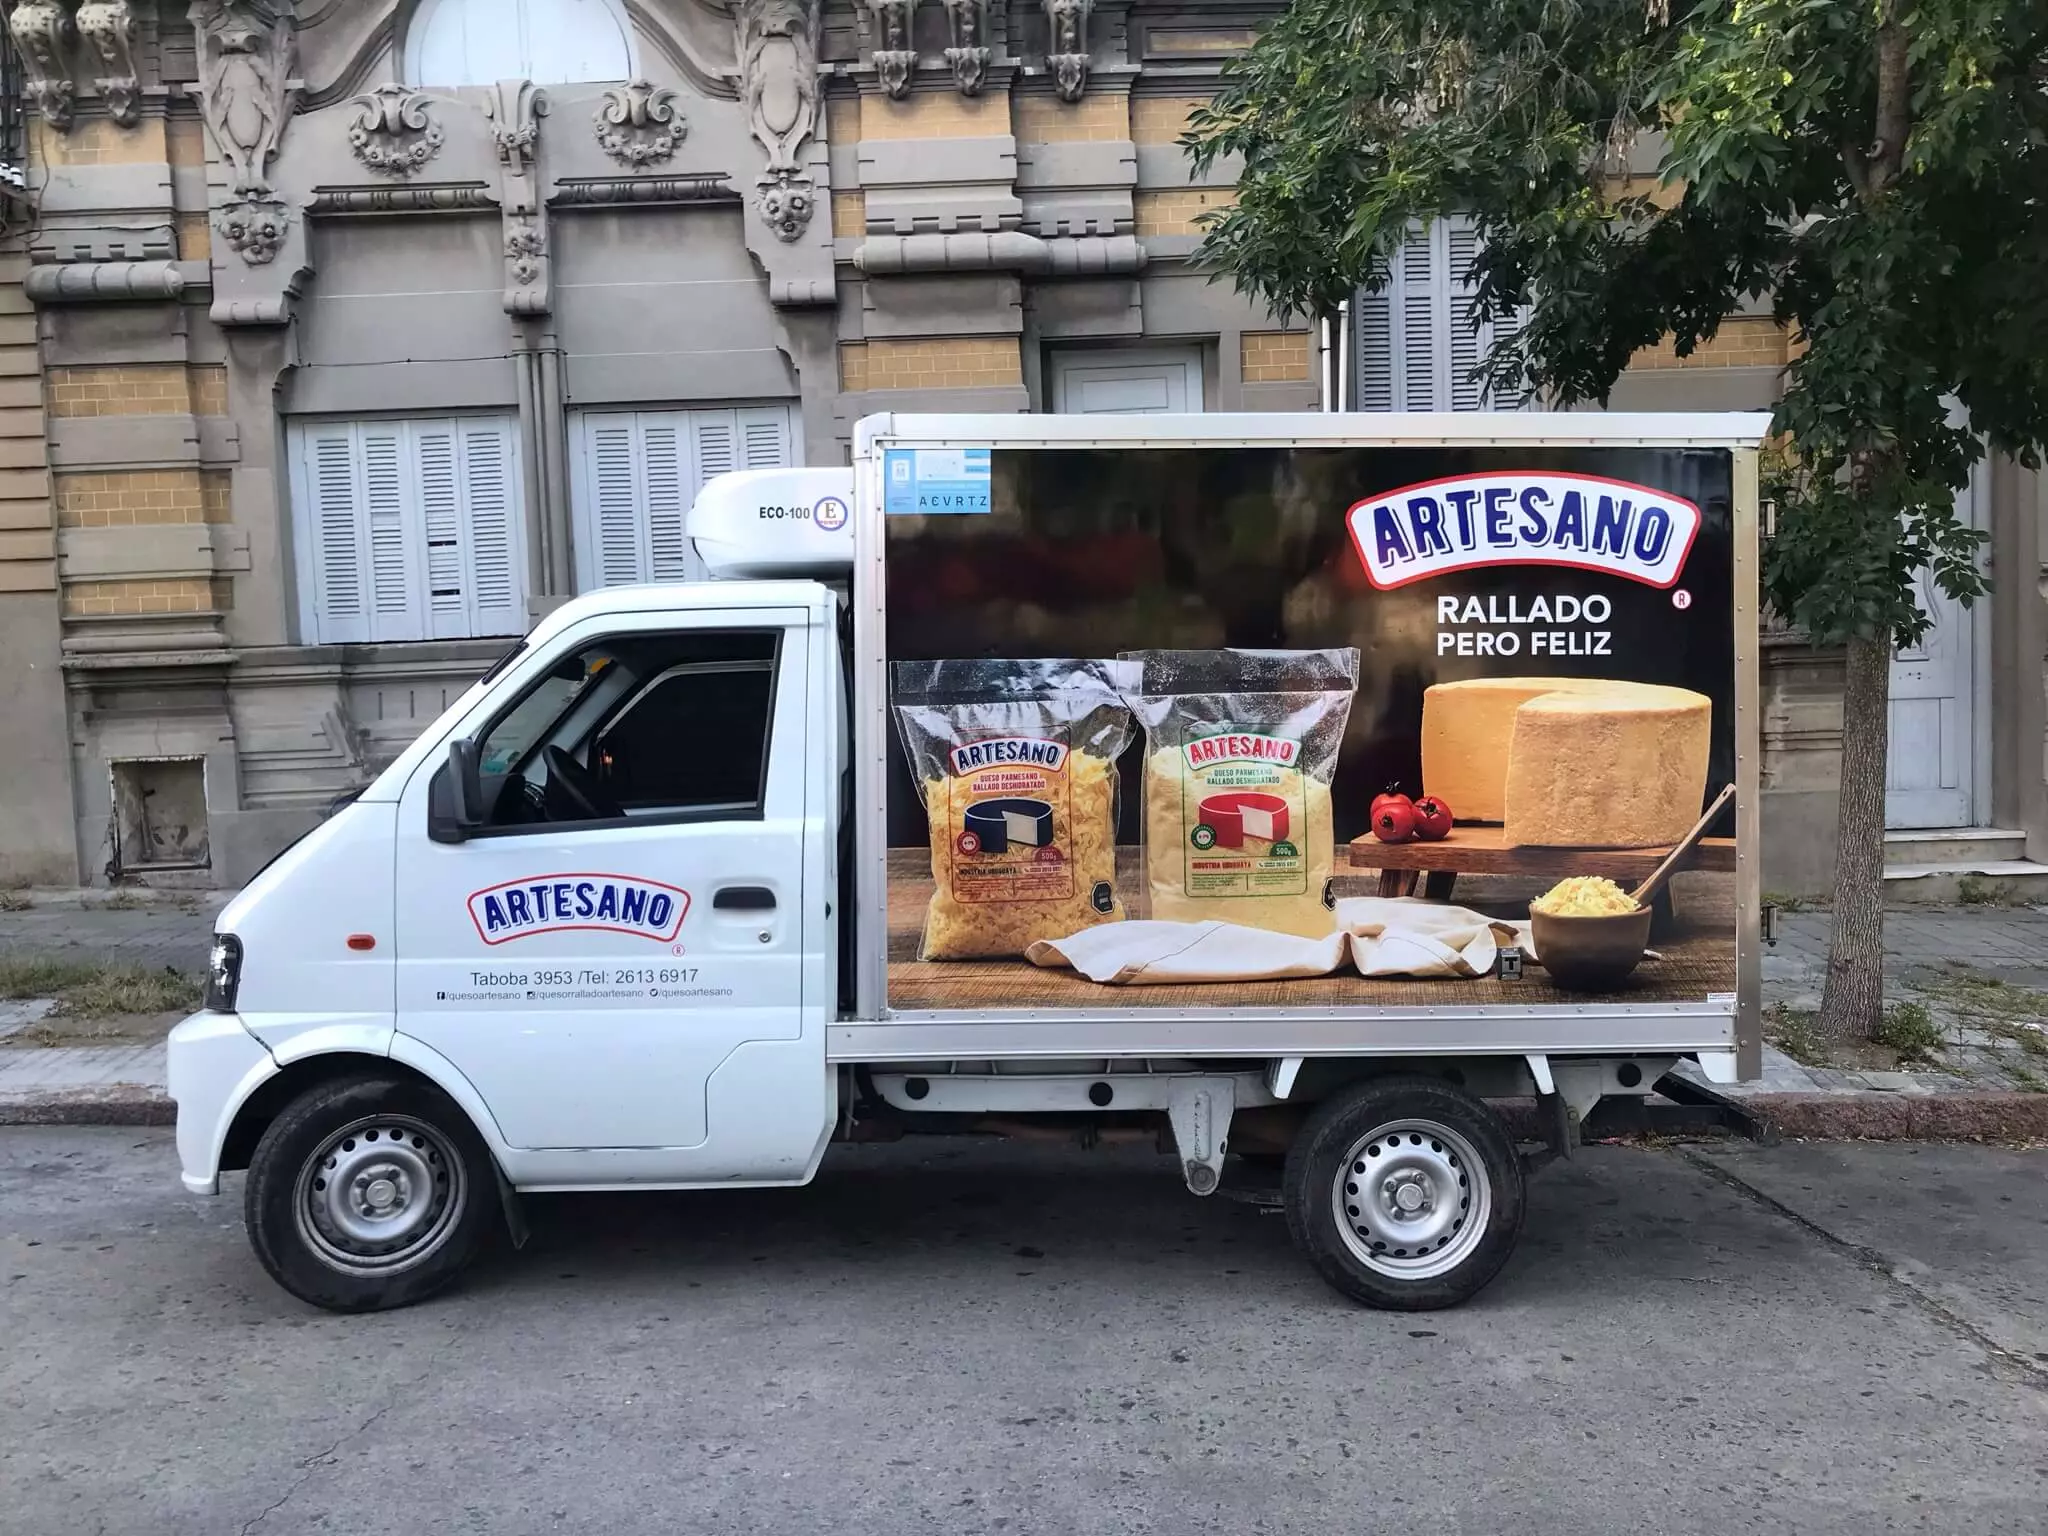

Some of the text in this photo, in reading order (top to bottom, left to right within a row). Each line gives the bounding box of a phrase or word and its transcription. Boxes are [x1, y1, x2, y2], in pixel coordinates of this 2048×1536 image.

[759, 506, 811, 519] ECO-100
[1372, 486, 1674, 568] ARTESANO
[1436, 593, 1613, 625] RALLADO
[1436, 631, 1613, 657] PERO FELIZ
[957, 740, 1061, 771] ARTESANO
[1190, 735, 1295, 764] ARTESANO
[484, 883, 675, 933] ARTESANO
[470, 972, 528, 986] Taboba
[533, 970, 573, 985] 3953
[615, 970, 655, 984] 2613
[659, 968, 699, 983] 6917
